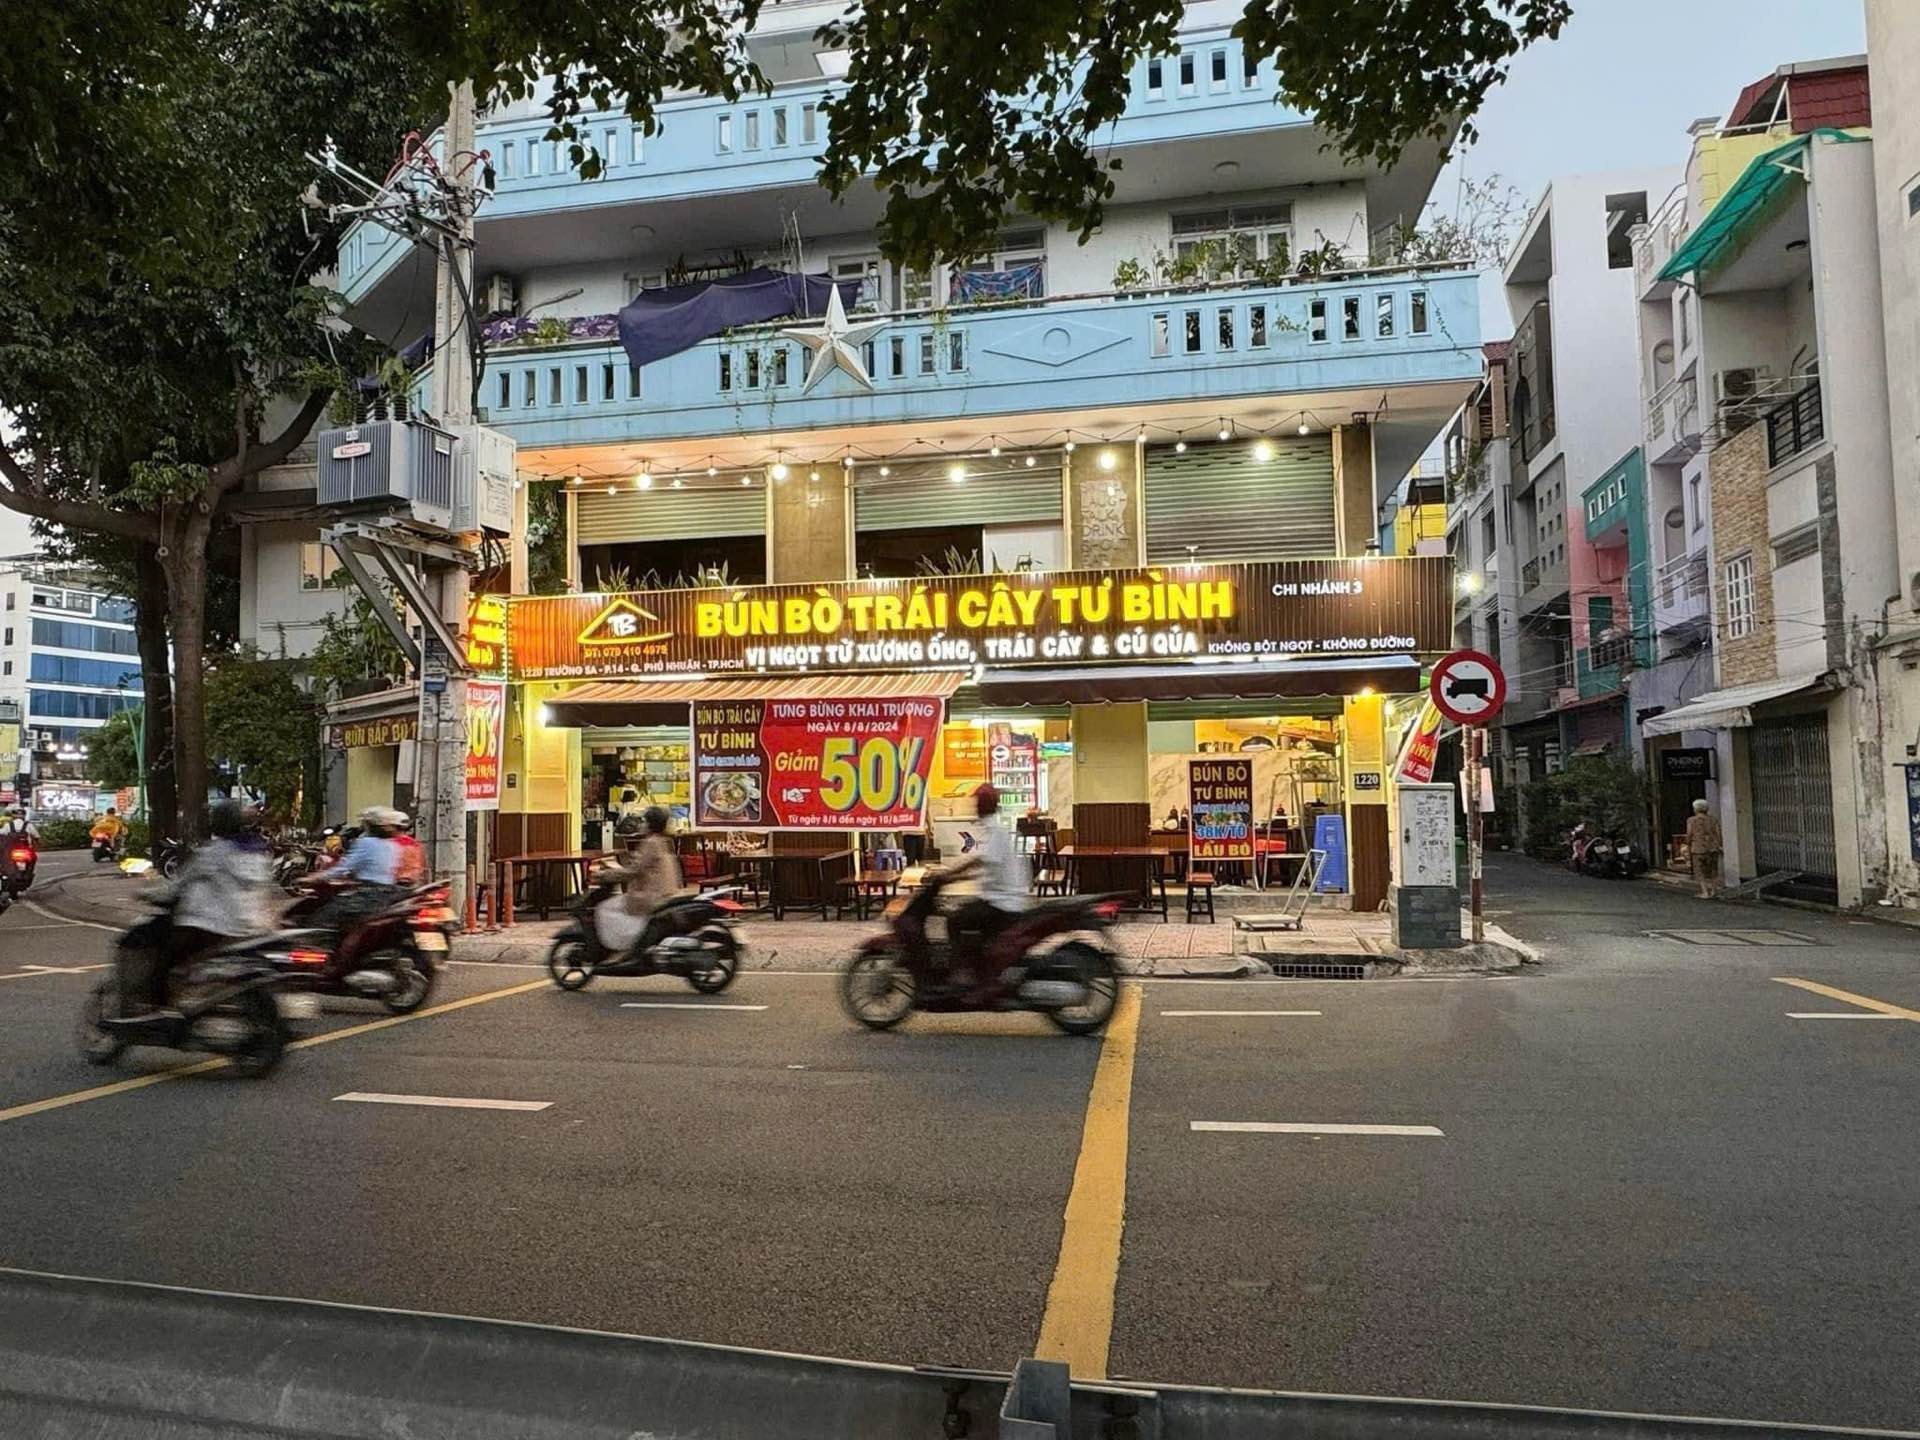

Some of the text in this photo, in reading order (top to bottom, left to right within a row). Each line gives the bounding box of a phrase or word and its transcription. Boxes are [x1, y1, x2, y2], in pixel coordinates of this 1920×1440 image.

[1272, 579, 1363, 596] CHI NHÁNH 3
[697, 571, 1234, 637] BÚN BÒ TRÁI CÂY TƯ BÌNH
[746, 645, 766, 673] VỊ
[769, 643, 822, 671] NGỌT
[825, 638, 855, 663] TỪ
[856, 639, 923, 662] XƯƠNG
[928, 632, 976, 663] ỐNG,
[983, 631, 1035, 659] TRÁI
[1041, 630, 1084, 656] CÂY
[1091, 636, 1109, 656] &
[1115, 626, 1149, 656] CỦ
[1208, 639, 1252, 653] KHÔNG
[1254, 638, 1277, 654] BỘT
[1280, 640, 1314, 654] NGỌT
[1323, 636, 1368, 651] KHÔNG
[1370, 634, 1416, 649] ĐƯỜNG
[708, 659, 745, 670] TP.HCM
[697, 705, 712, 725] BÚN
[726, 704, 743, 724] TRÁI
[744, 704, 761, 724] CÂY
[848, 703, 880, 717] KHAI
[882, 701, 935, 717] TRƯƠNG
[807, 720, 899, 733] NGÀY 8/8/2024
[699, 728, 755, 750] TƯ BÌNH
[775, 749, 819, 772] Giảm
[819, 736, 926, 811] 50%
[1193, 762, 1248, 782] BÚN BÒ
[1355, 774, 1379, 787] 1220
[1194, 783, 1249, 800] TƯ BÌNH
[788, 814, 799, 824] Từ
[800, 814, 821, 826] ngày
[856, 815, 877, 826] ngày
